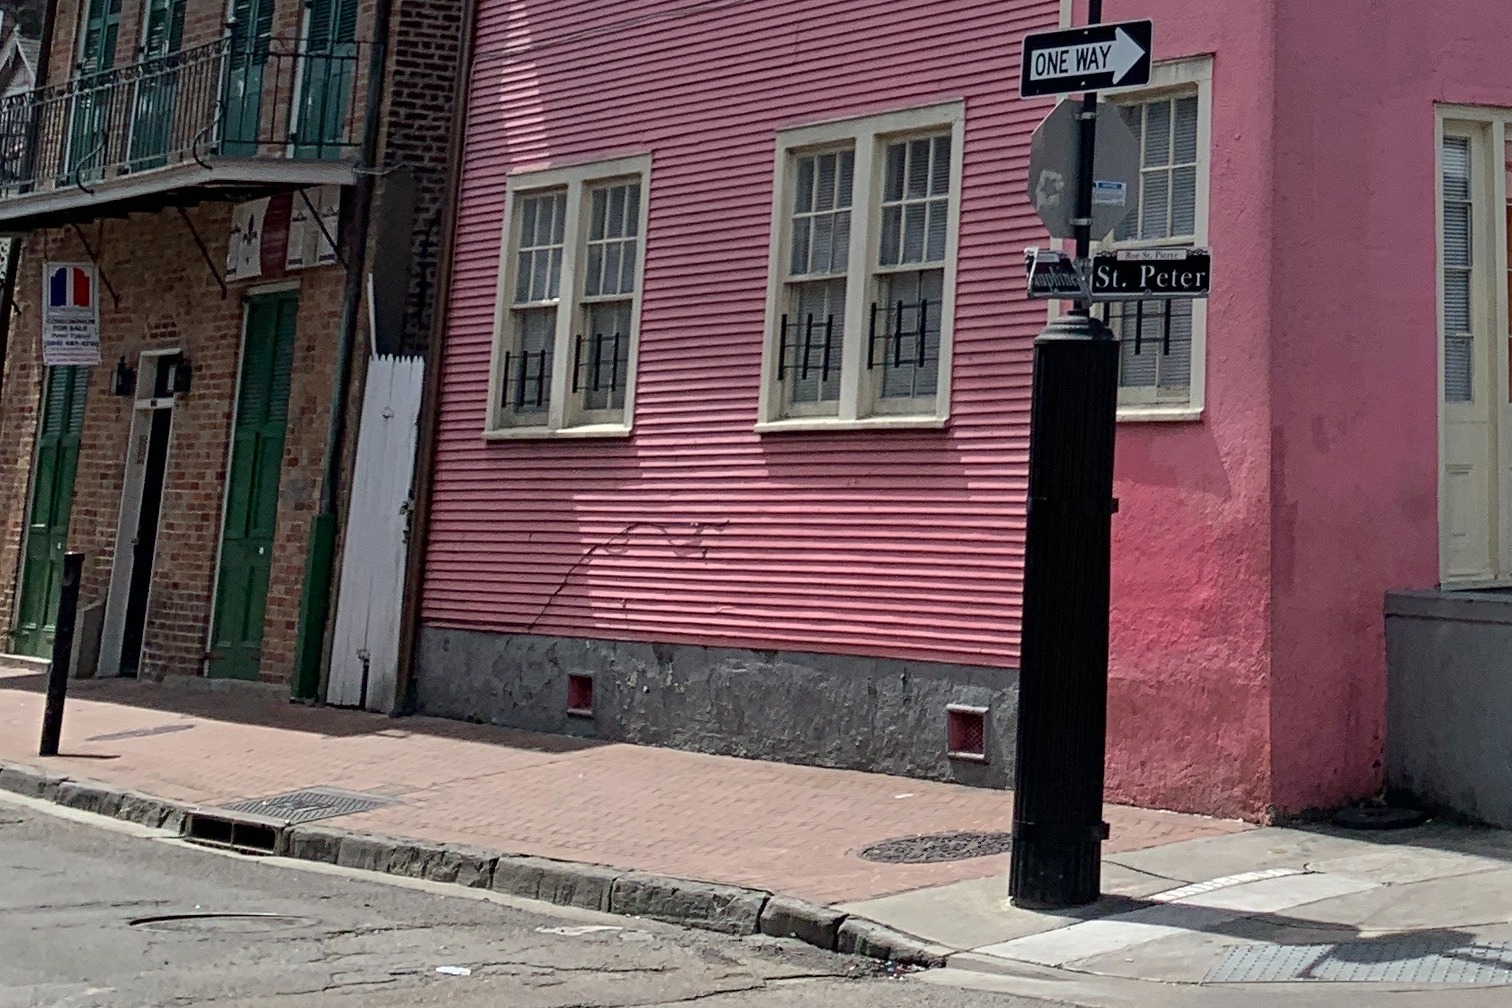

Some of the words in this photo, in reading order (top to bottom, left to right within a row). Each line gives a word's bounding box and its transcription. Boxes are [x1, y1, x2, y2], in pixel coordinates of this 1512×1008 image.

[1035, 49, 1069, 76] ONE
[1076, 44, 1112, 72] WAY
[1096, 265, 1127, 288] St.
[1139, 265, 1206, 288] Peter
